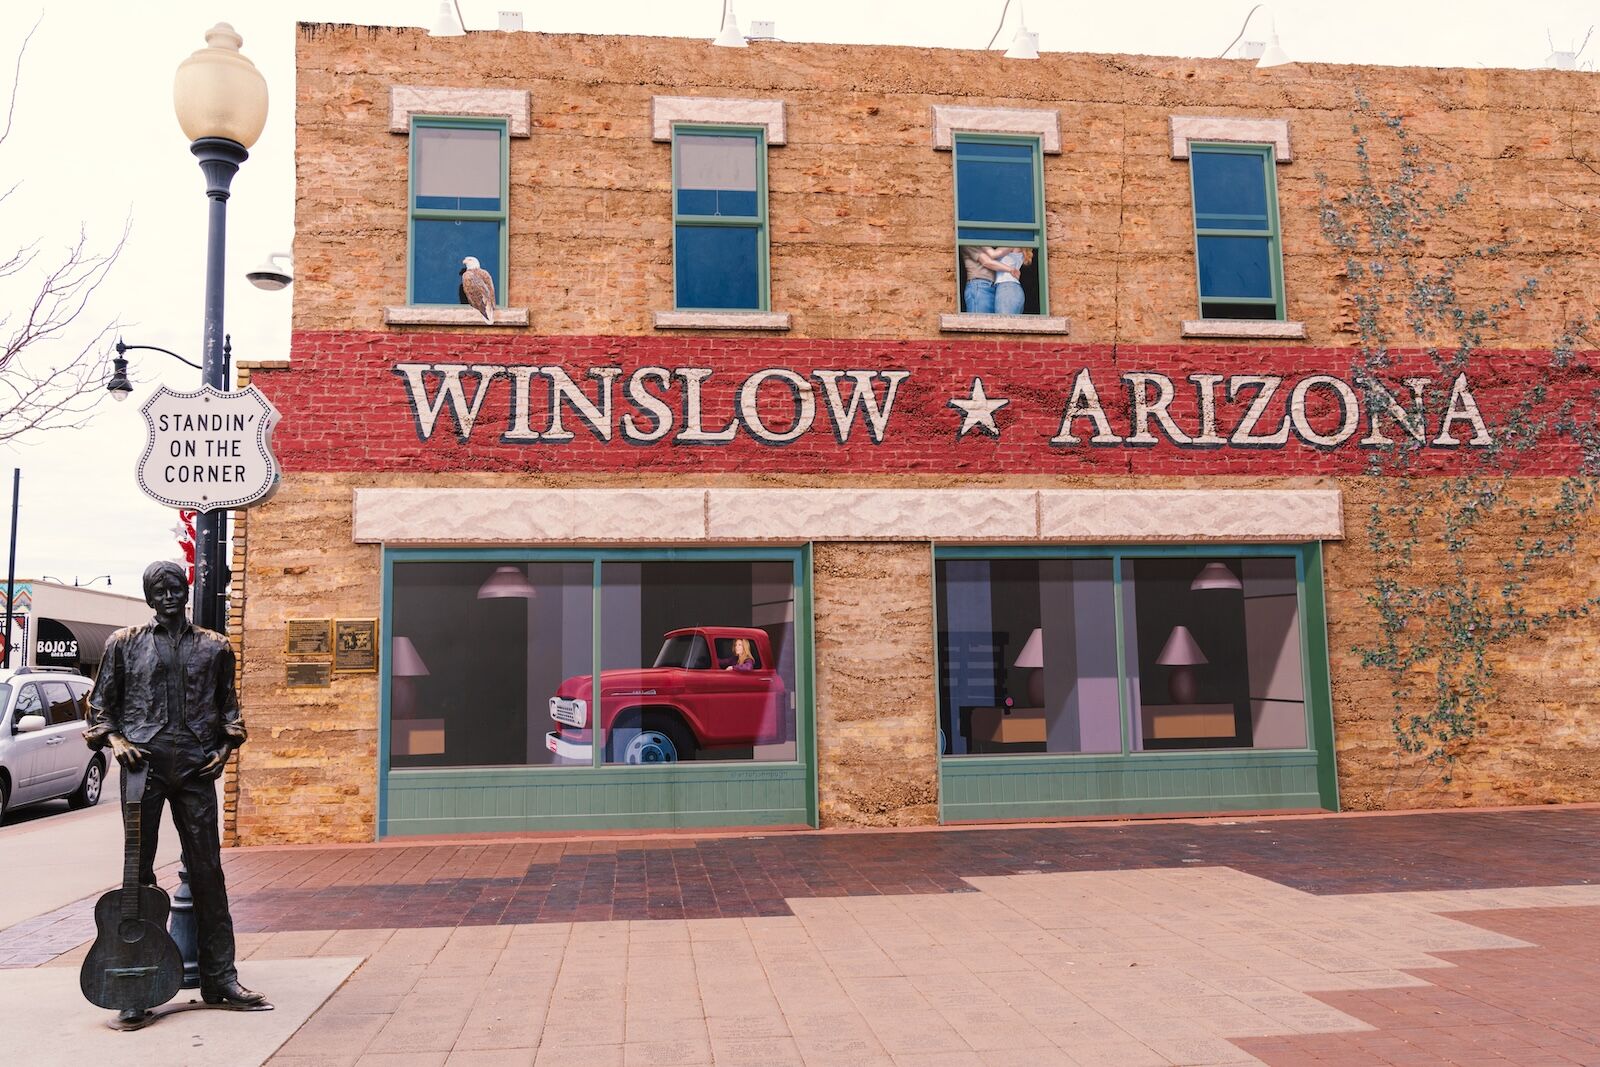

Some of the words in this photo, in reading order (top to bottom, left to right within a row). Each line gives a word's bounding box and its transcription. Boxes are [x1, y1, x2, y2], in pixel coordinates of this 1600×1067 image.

[392, 363, 911, 445] WINSLOW
[1049, 367, 1495, 449] ARIZONA
[159, 414, 254, 432] STANDIN'
[170, 440, 196, 457] ON
[205, 440, 241, 457] THE
[165, 465, 245, 483] CORNER
[37, 640, 78, 653] BOJO'S
